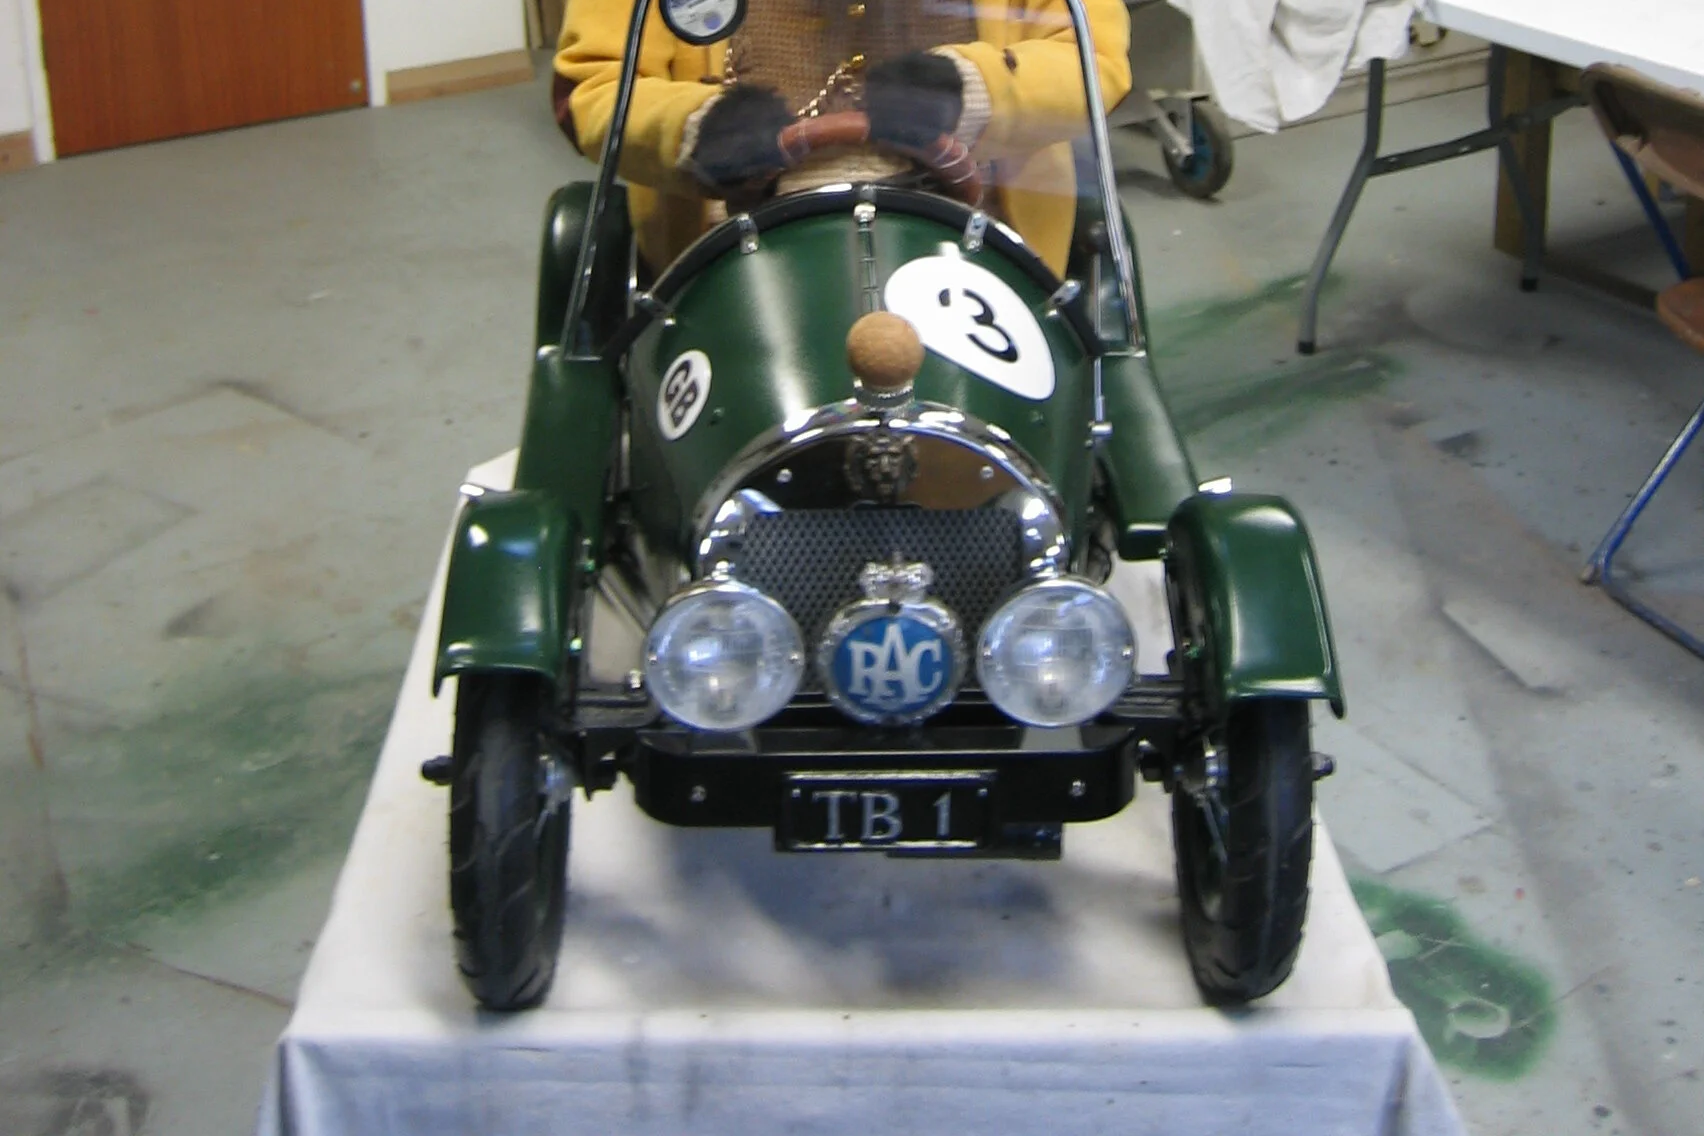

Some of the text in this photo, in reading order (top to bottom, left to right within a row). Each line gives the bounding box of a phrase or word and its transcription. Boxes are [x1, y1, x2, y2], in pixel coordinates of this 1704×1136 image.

[938, 287, 1019, 364] 3
[664, 359, 698, 428] GB
[847, 622, 944, 705] RAC
[811, 789, 952, 842] TB 1
